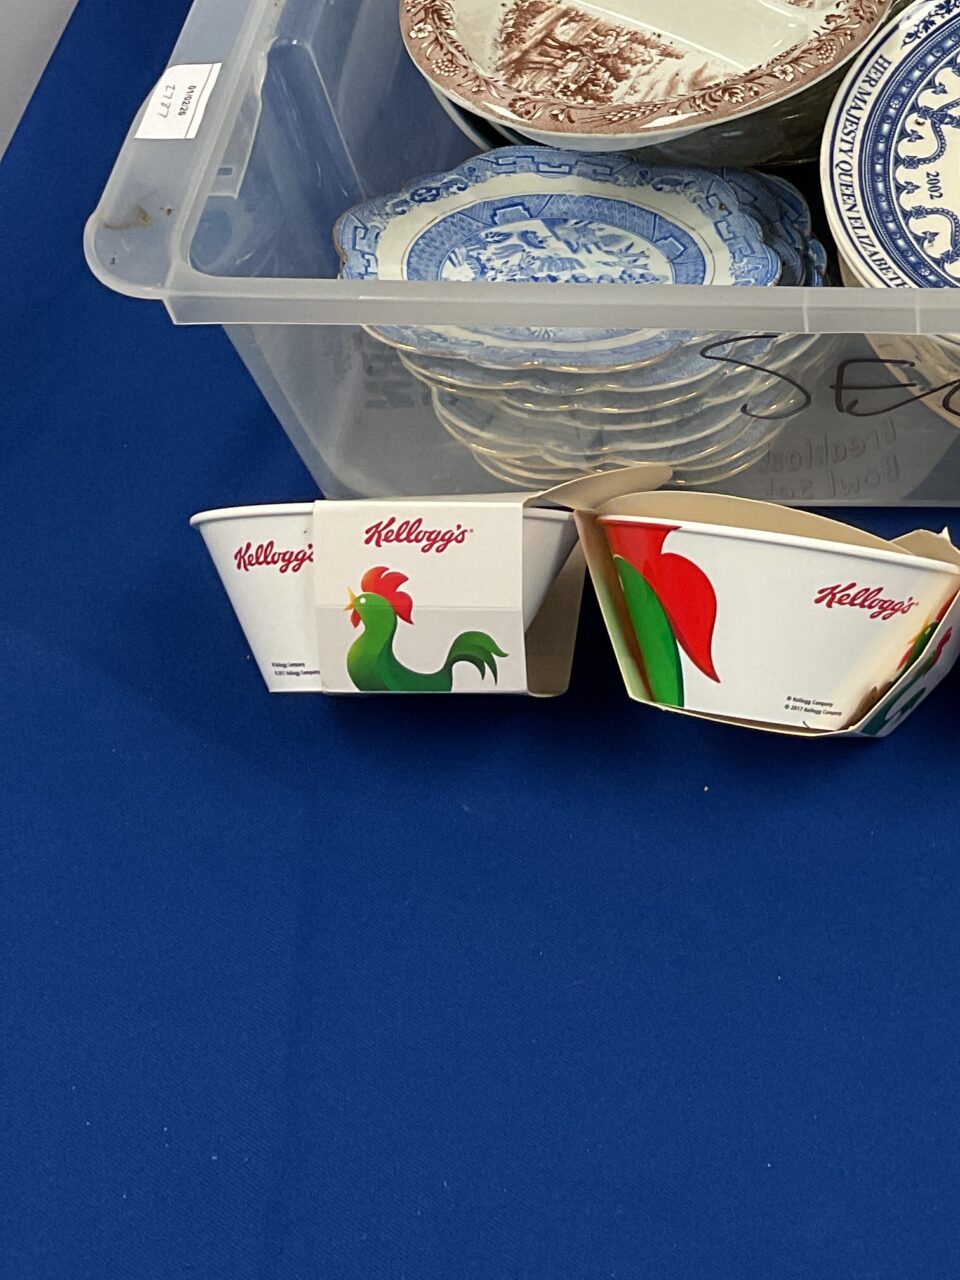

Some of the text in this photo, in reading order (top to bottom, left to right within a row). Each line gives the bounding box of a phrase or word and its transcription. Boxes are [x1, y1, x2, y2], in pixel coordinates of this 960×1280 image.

[862, 54, 892, 88] HER
[839, 86, 872, 159] MAJESTY
[835, 160, 860, 213] QUEEN
[925, 171, 944, 200] 2002
[364, 517, 467, 553] Kellogg's
[814, 582, 915, 621] Kellogg's
